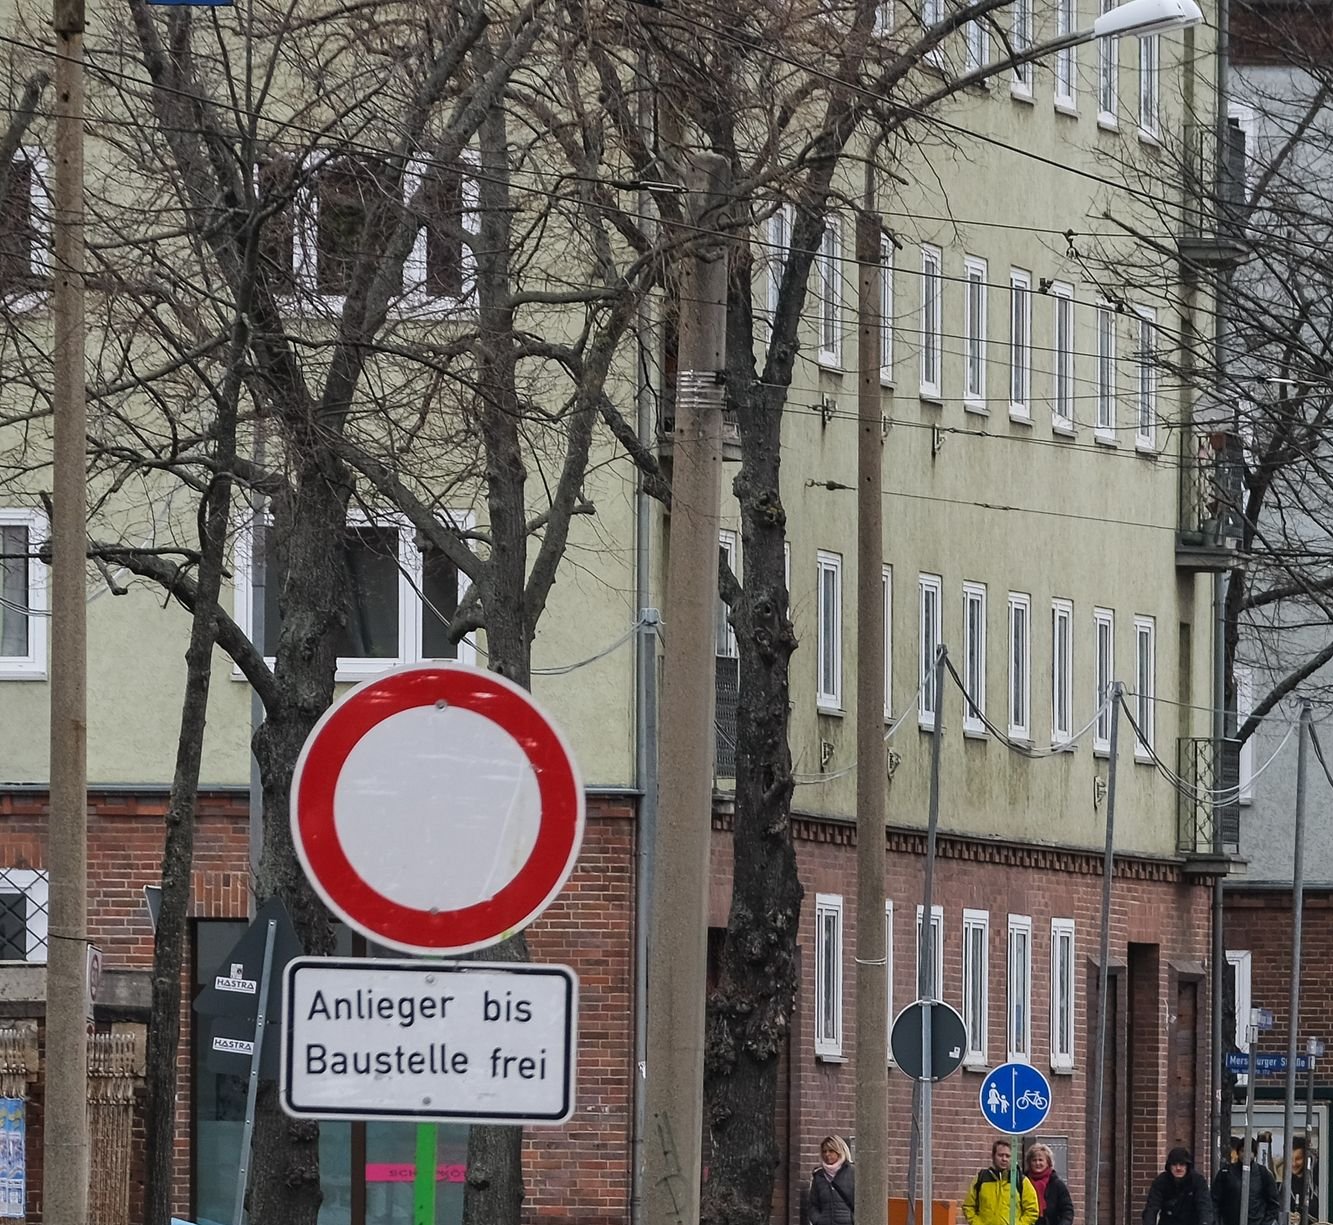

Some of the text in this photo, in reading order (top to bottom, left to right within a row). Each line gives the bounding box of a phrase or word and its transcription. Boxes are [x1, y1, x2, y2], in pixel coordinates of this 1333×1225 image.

[216, 978, 255, 990] HASTRA
[307, 989, 533, 1028] Anlieger bis
[214, 1038, 252, 1051] HASTRA
[305, 1042, 547, 1080] Baustelle frei
[1229, 1055, 1277, 1068] Mersurger
